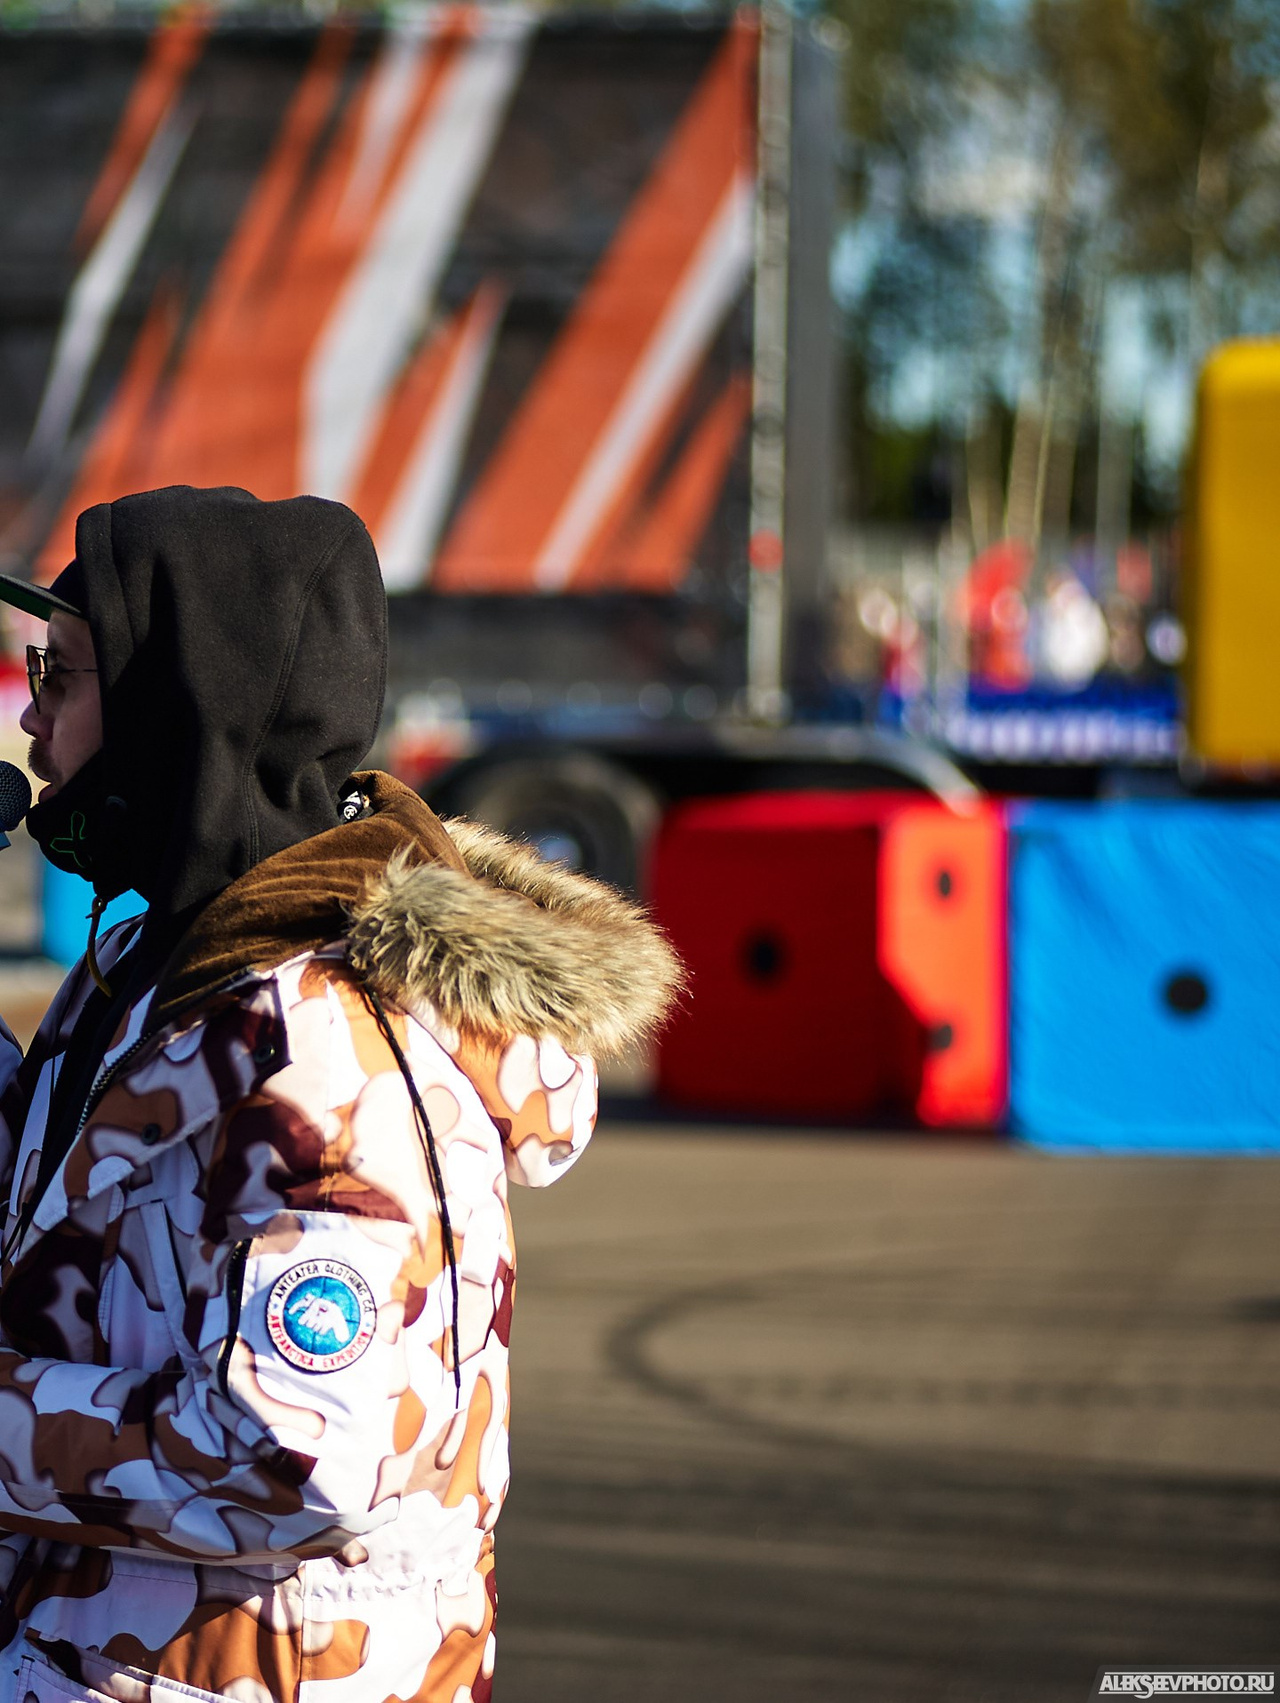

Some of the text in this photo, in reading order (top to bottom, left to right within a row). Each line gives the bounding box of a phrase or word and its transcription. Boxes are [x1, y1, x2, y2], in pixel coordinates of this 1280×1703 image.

[275, 1263, 319, 1300] ANTEATER
[324, 1263, 367, 1296] CLOTHING
[323, 1330, 370, 1367] EXPEDITION
